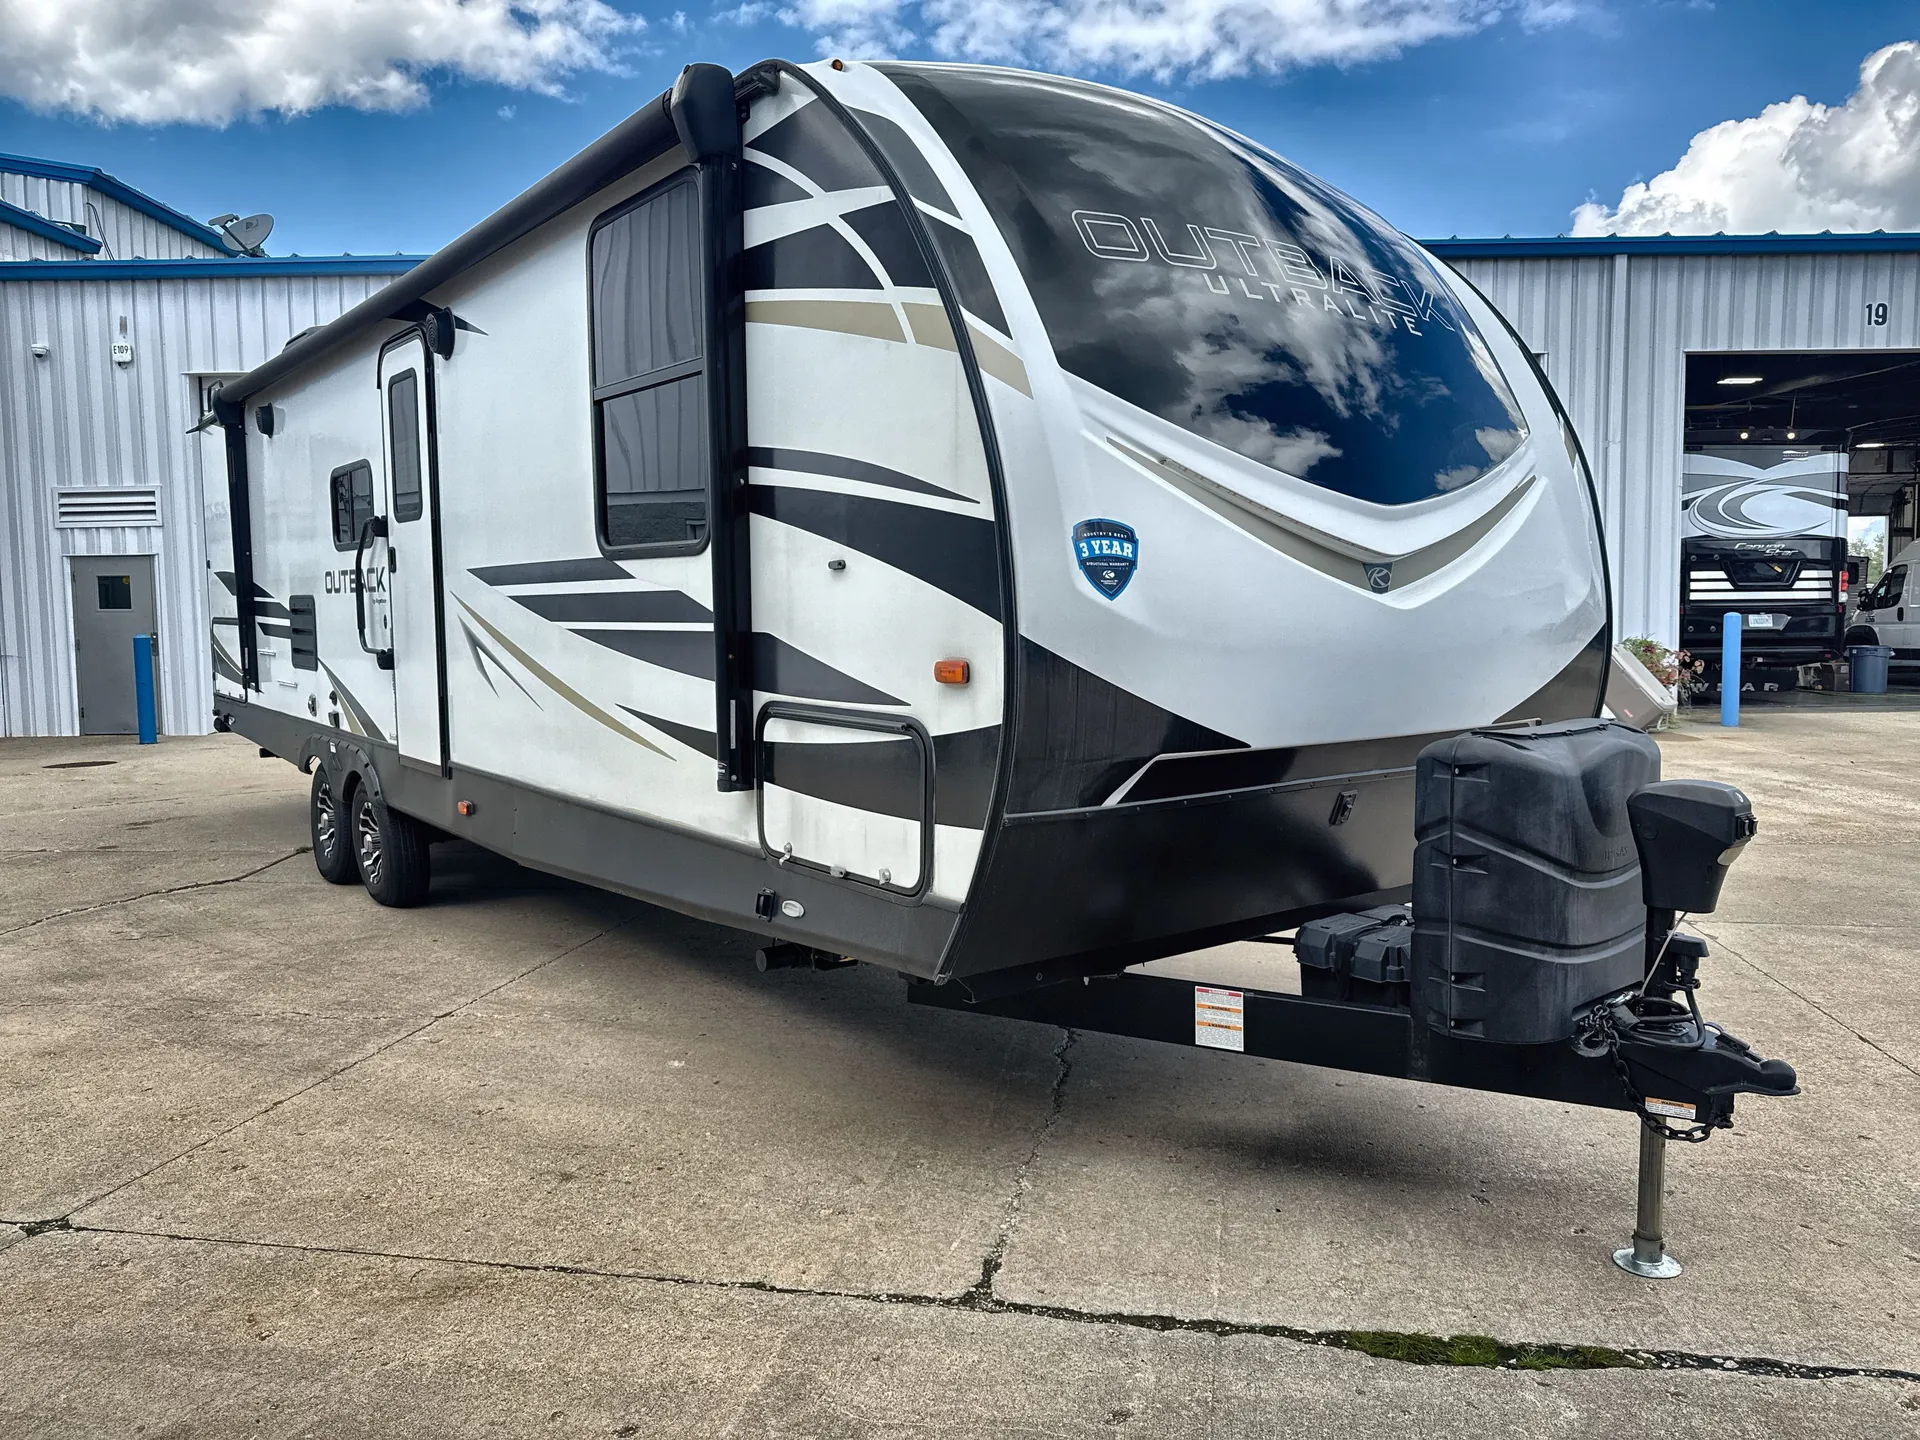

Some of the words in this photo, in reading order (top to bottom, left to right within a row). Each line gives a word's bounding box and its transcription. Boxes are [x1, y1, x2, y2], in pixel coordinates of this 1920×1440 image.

[1071, 209, 1455, 331] OUTBACK
[1203, 272, 1422, 337] ULTRALITE
[1866, 303, 1888, 326] 19
[113, 345, 129, 355] E109
[1079, 542, 1089, 557] 3
[1090, 539, 1133, 558] YEAR
[1734, 542, 1786, 552] Canyon
[1764, 548, 1799, 556] Star
